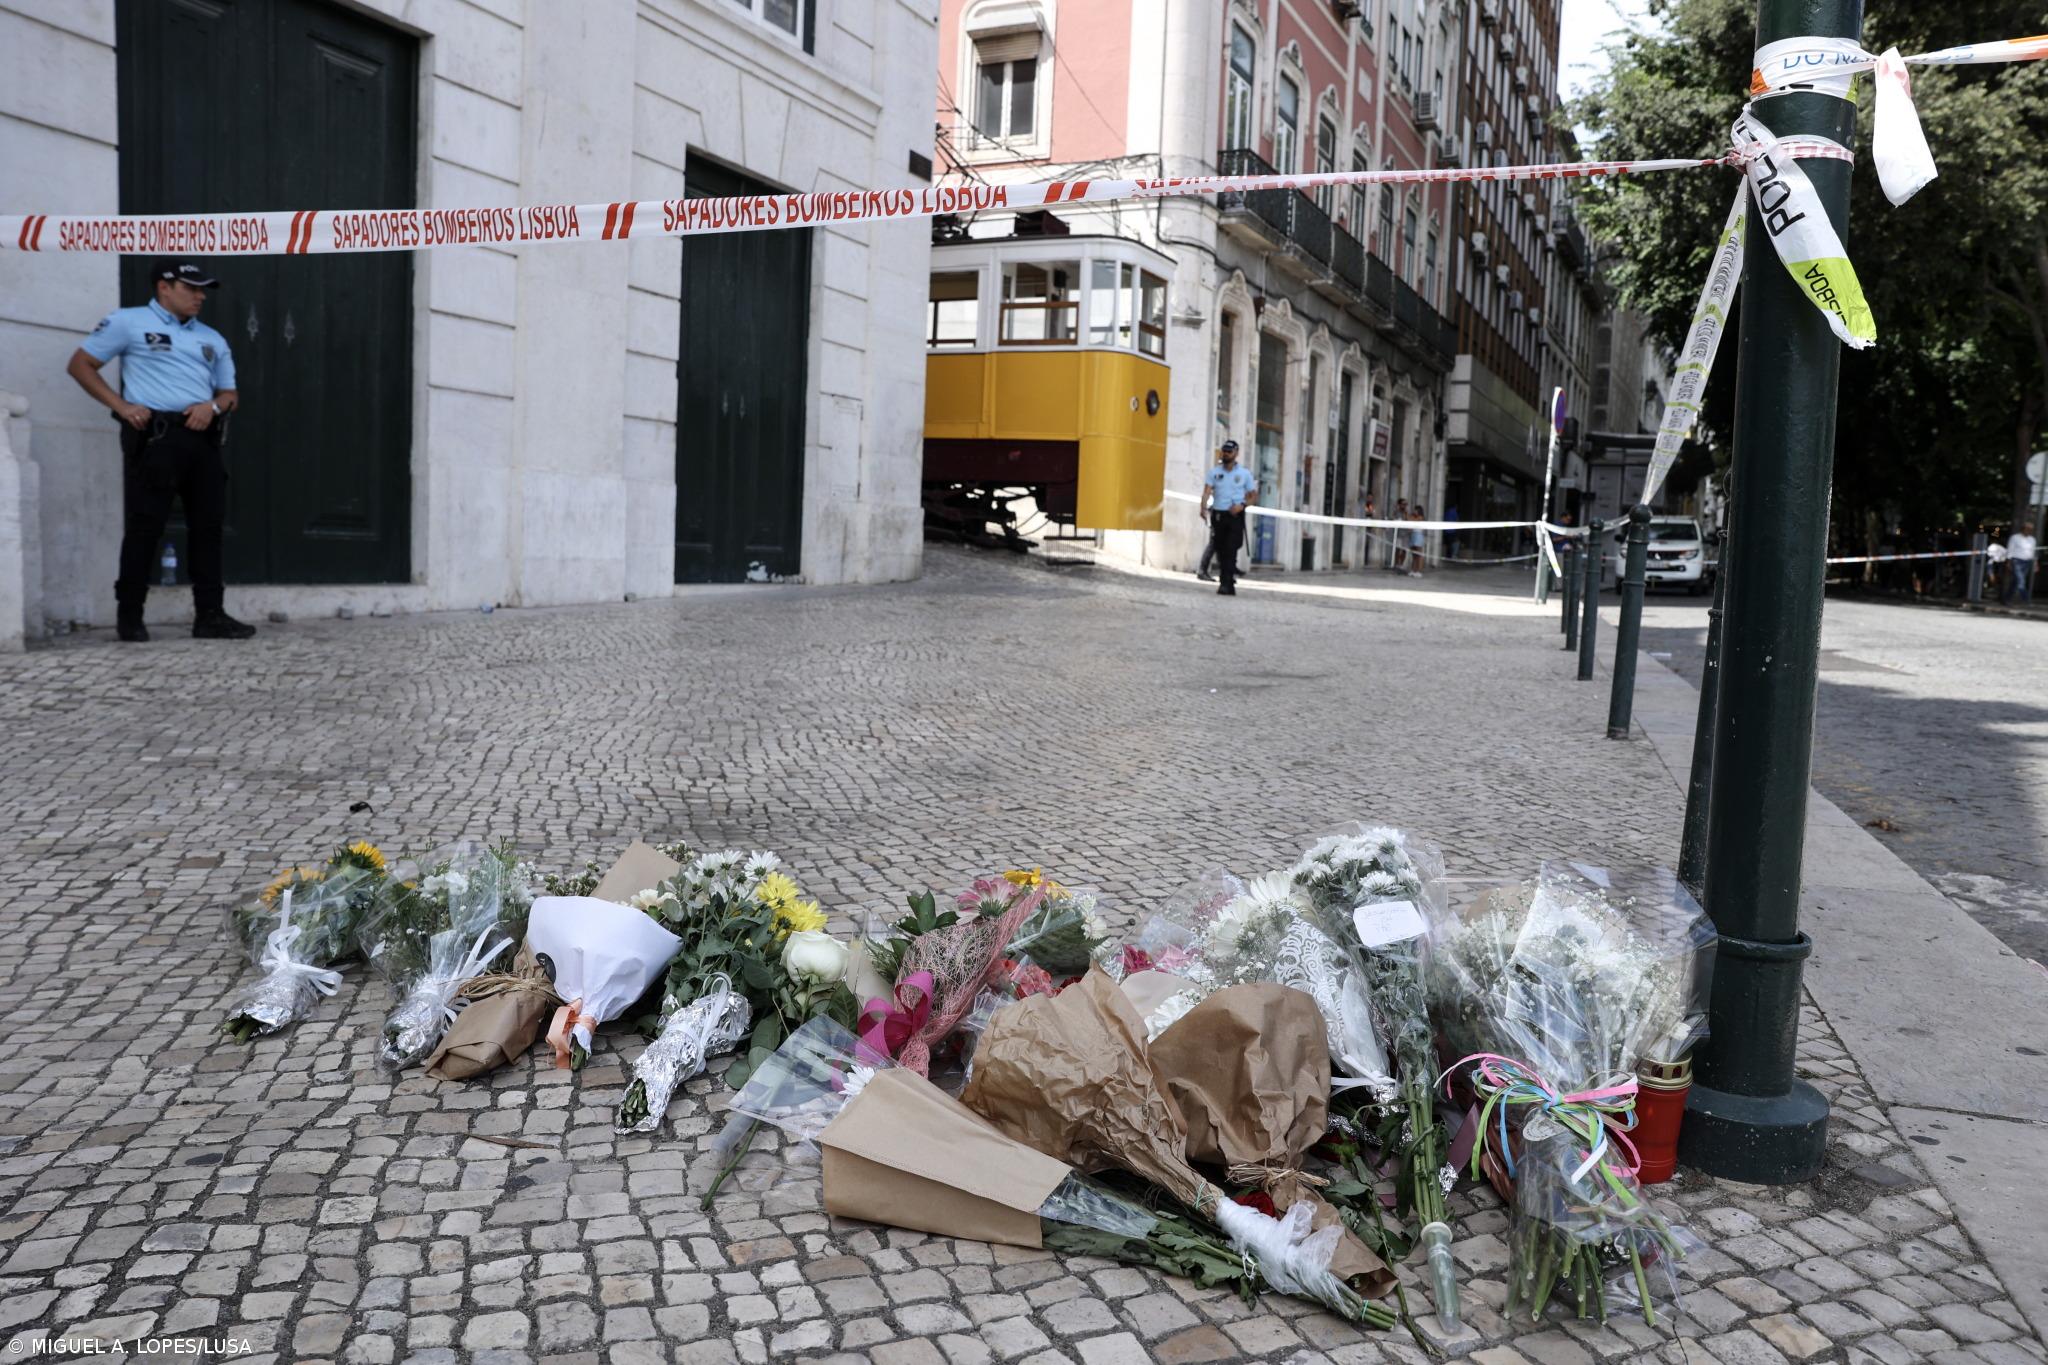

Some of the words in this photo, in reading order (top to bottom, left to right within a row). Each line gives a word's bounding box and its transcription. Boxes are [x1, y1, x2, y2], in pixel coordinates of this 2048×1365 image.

[333, 211, 420, 249] SAPADORES
[423, 207, 515, 245] BOMBEIROS
[519, 205, 580, 240] LISBOA
[662, 193, 779, 232] SAPADORES
[786, 189, 914, 223] BOMBEIROS
[921, 185, 1008, 214] LISBOA
[59, 220, 134, 252] SAPADORES
[139, 219, 216, 252] BOMBEIROS
[220, 217, 268, 252] LISBOA
